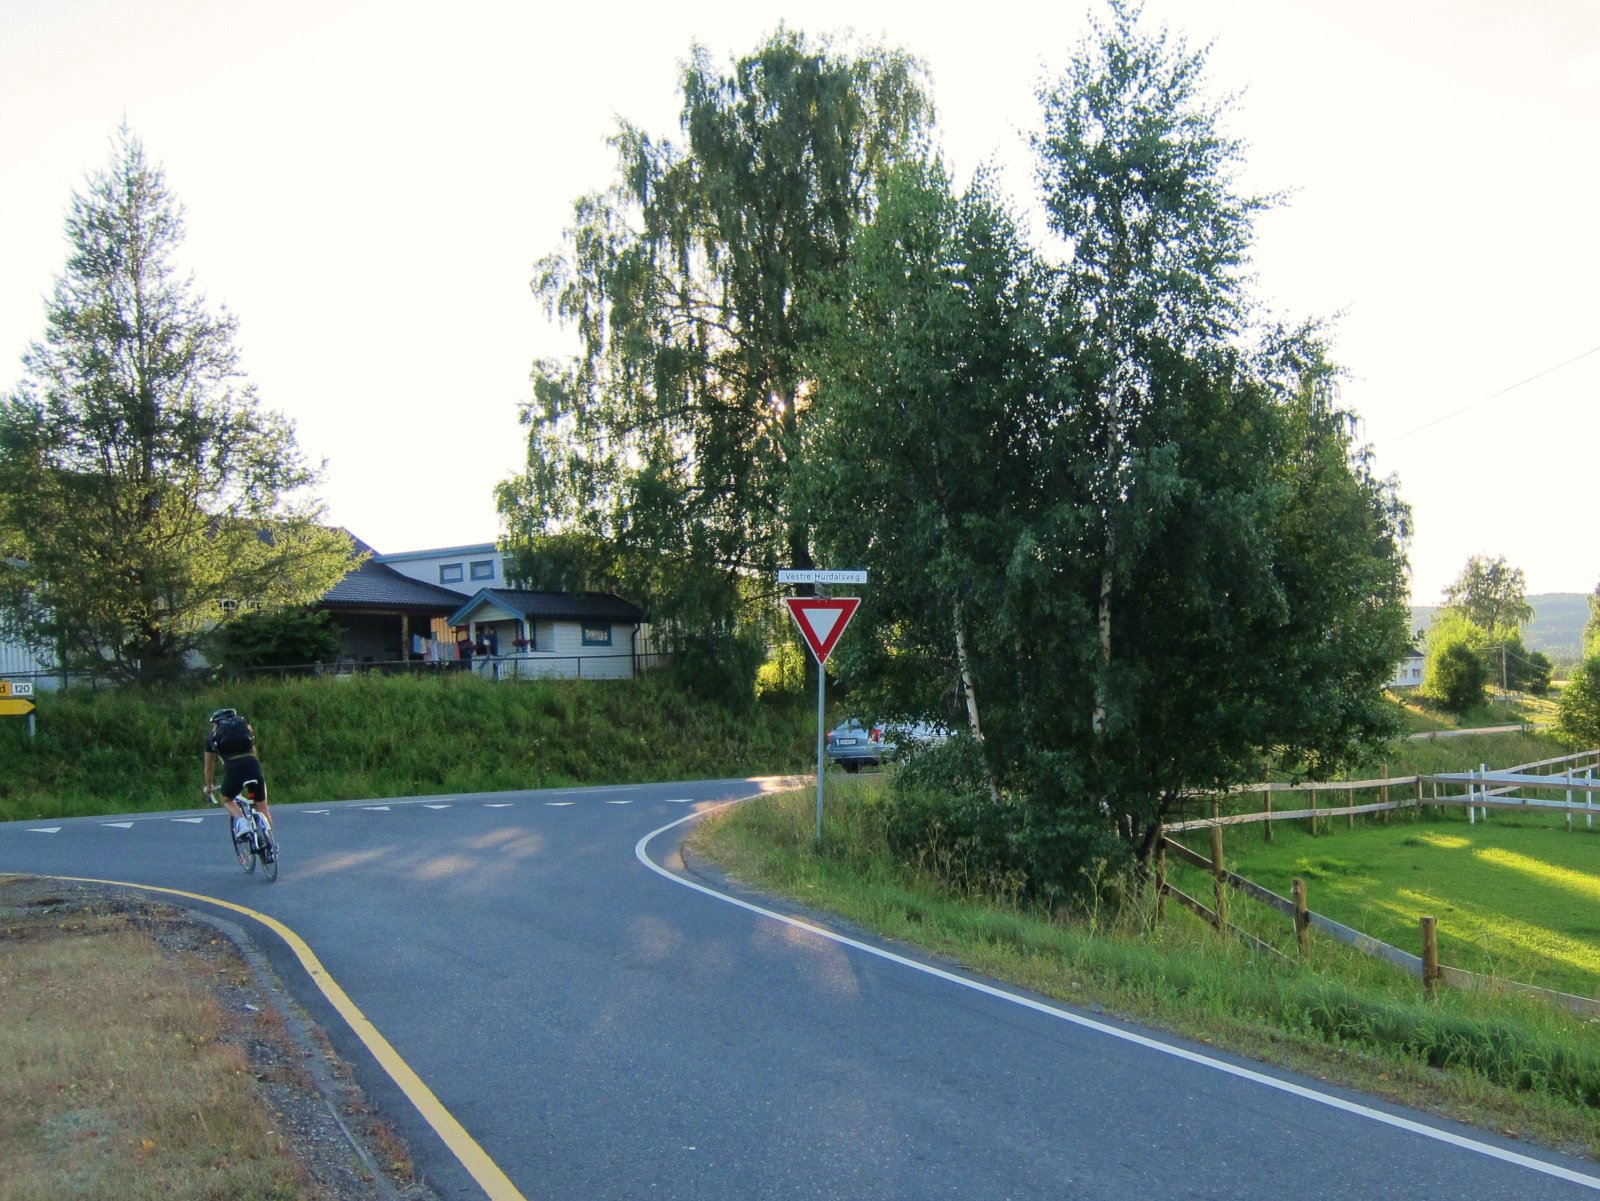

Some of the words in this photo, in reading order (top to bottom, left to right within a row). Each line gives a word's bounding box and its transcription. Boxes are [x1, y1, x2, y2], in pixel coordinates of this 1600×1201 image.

[785, 572, 811, 580] Vestre
[815, 572, 860, 582] Hurdalsveg
[14, 684, 30, 693] 120
